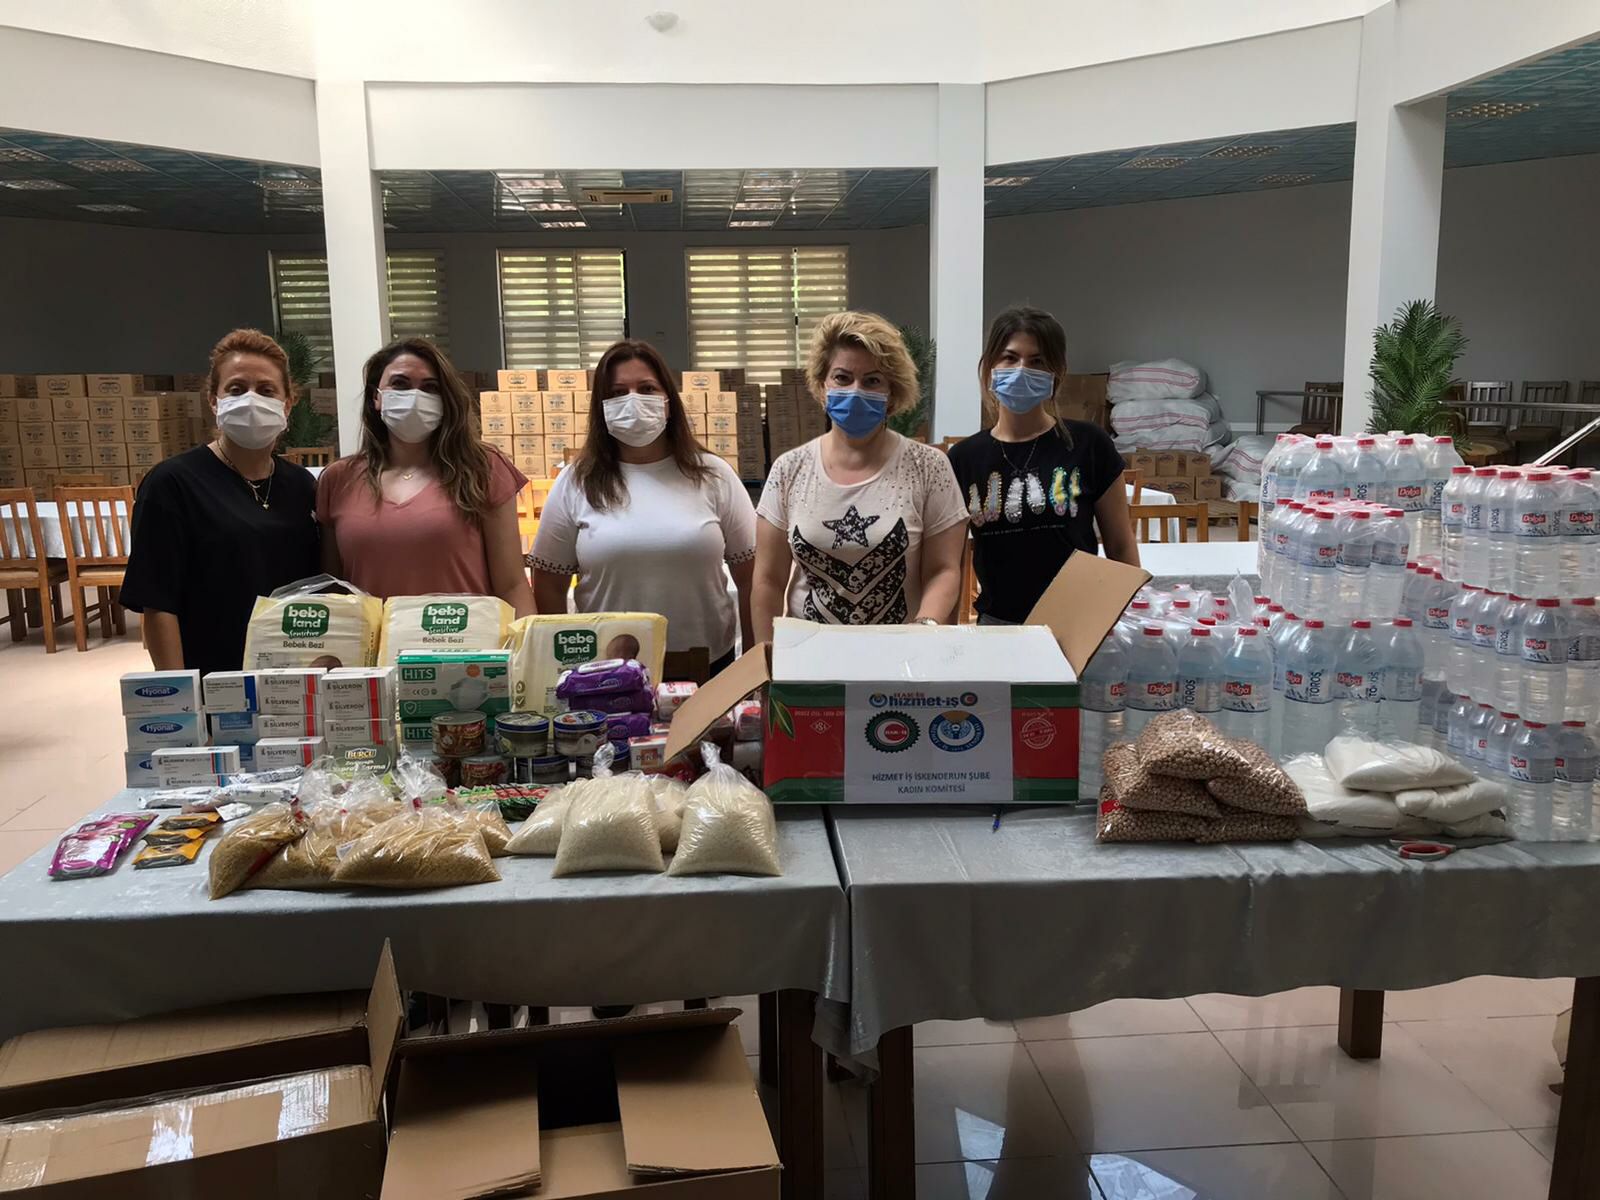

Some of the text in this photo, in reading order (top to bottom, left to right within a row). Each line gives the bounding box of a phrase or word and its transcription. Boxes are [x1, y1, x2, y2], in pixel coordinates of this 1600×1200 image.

[1357, 483, 1367, 499] ROS
[288, 605, 327, 619] bebe
[427, 605, 465, 616] bebe
[292, 618, 321, 628] land
[432, 616, 460, 625] land
[289, 629, 320, 639] Sensitive
[428, 626, 459, 635] Sensitive
[558, 633, 595, 644] bebe
[283, 640, 324, 649] Bebek Bezi
[563, 644, 590, 654] land
[1310, 671, 1322, 697] TOROS
[1185, 679, 1196, 705] TOROS
[872, 771, 991, 782] HİZMET İŞ İSKENDERUN ŞUBE
[898, 784, 966, 794] KADIN KOMİTESİ
